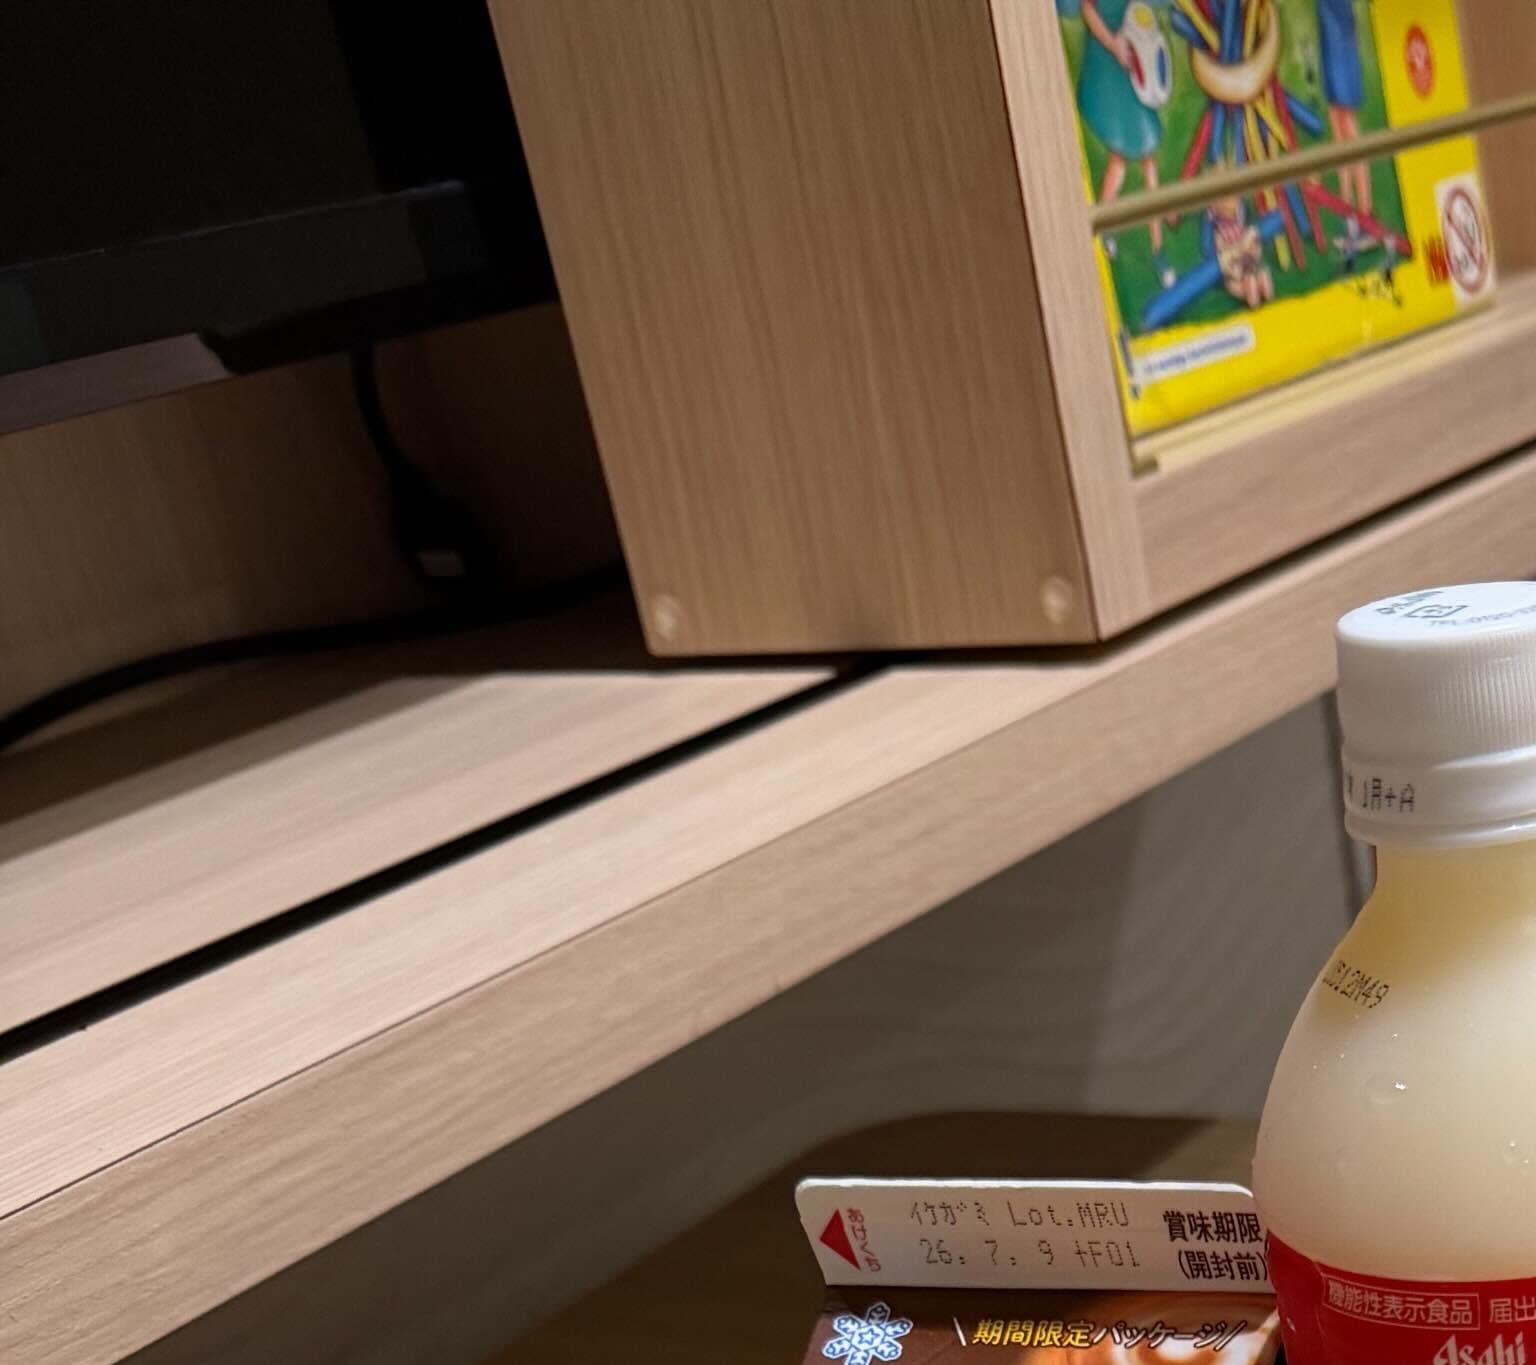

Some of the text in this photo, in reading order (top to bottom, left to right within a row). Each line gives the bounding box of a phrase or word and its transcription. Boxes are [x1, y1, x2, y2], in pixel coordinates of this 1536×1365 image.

[1162, 1207, 1263, 1245] 賞味期限
[1176, 1250, 1269, 1283] (開封前)
[1327, 1280, 1474, 1326] 機能性表示食品
[972, 1317, 1226, 1351] 期間限定パッケージ
